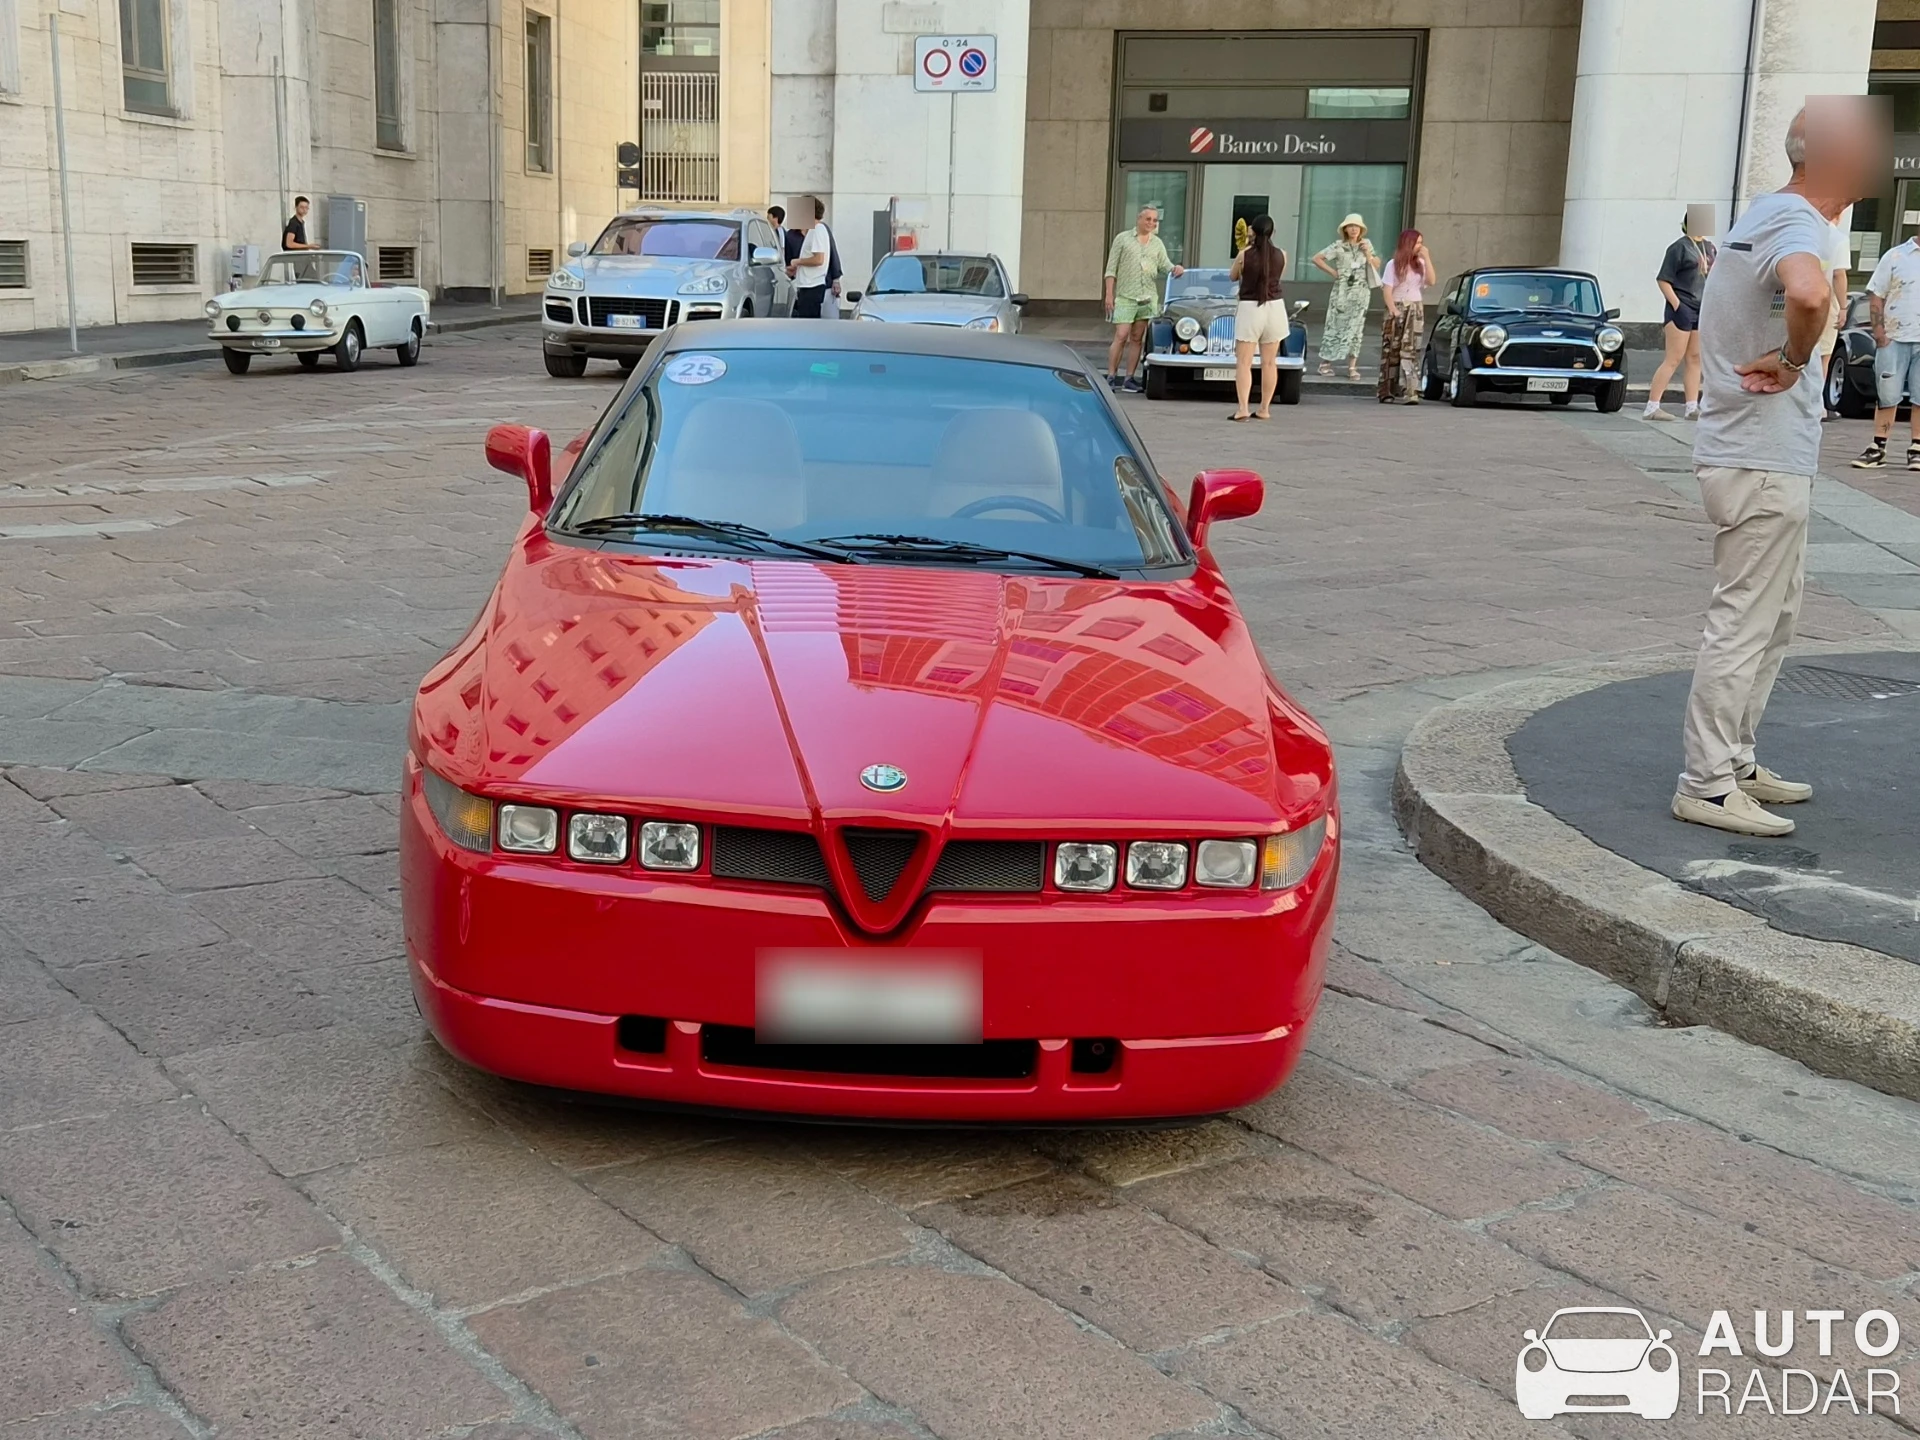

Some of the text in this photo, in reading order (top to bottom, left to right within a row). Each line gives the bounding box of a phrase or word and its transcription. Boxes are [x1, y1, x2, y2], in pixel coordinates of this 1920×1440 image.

[956, 39, 968, 47] 24
[1219, 134, 1336, 154] Banco Desio
[678, 363, 713, 376] 25
